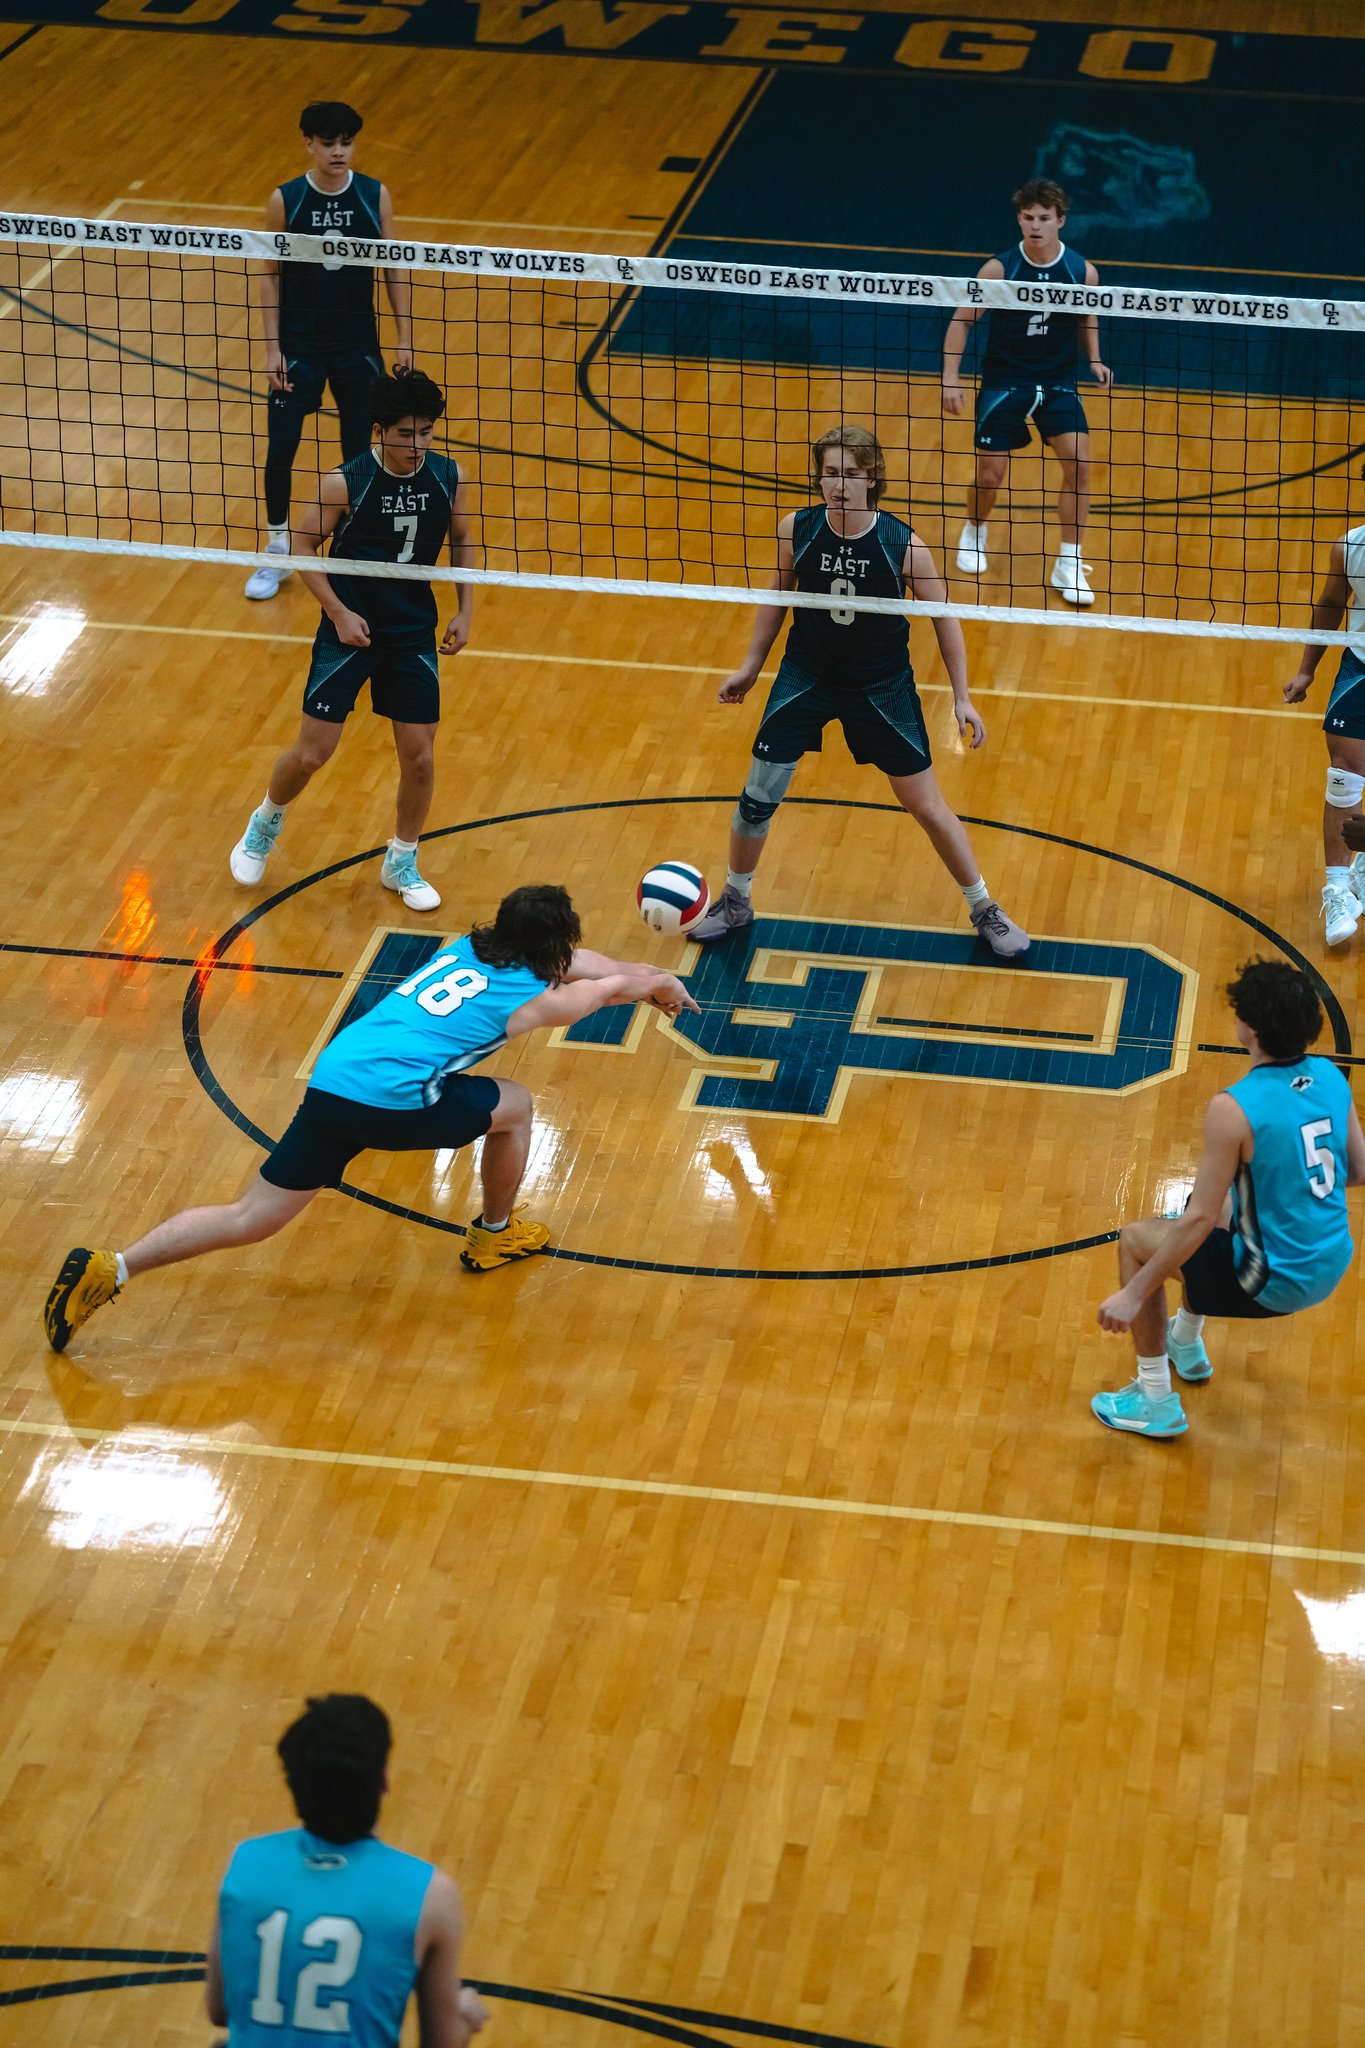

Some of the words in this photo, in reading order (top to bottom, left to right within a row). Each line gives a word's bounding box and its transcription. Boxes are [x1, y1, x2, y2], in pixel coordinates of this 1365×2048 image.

[311, 210, 354, 227] EAST
[84, 224, 142, 243] EAST
[149, 230, 243, 250] WOLVES
[322, 241, 416, 261] OSWEGO
[424, 248, 483, 267] EAST
[490, 253, 585, 273] WOLVES
[666, 264, 761, 286] OSWEGO
[770, 271, 830, 290] EAST
[838, 276, 934, 297] WOLVES
[1017, 286, 1114, 309] OSWEGO
[1122, 294, 1183, 312] EAST
[1191, 298, 1290, 320] WOLVES
[381, 493, 430, 513] EAST
[393, 515, 418, 563] 7
[820, 553, 870, 578] EAST
[394, 954, 490, 1018] 18
[1300, 1116, 1337, 1200] 5
[251, 1907, 364, 2035] 12
